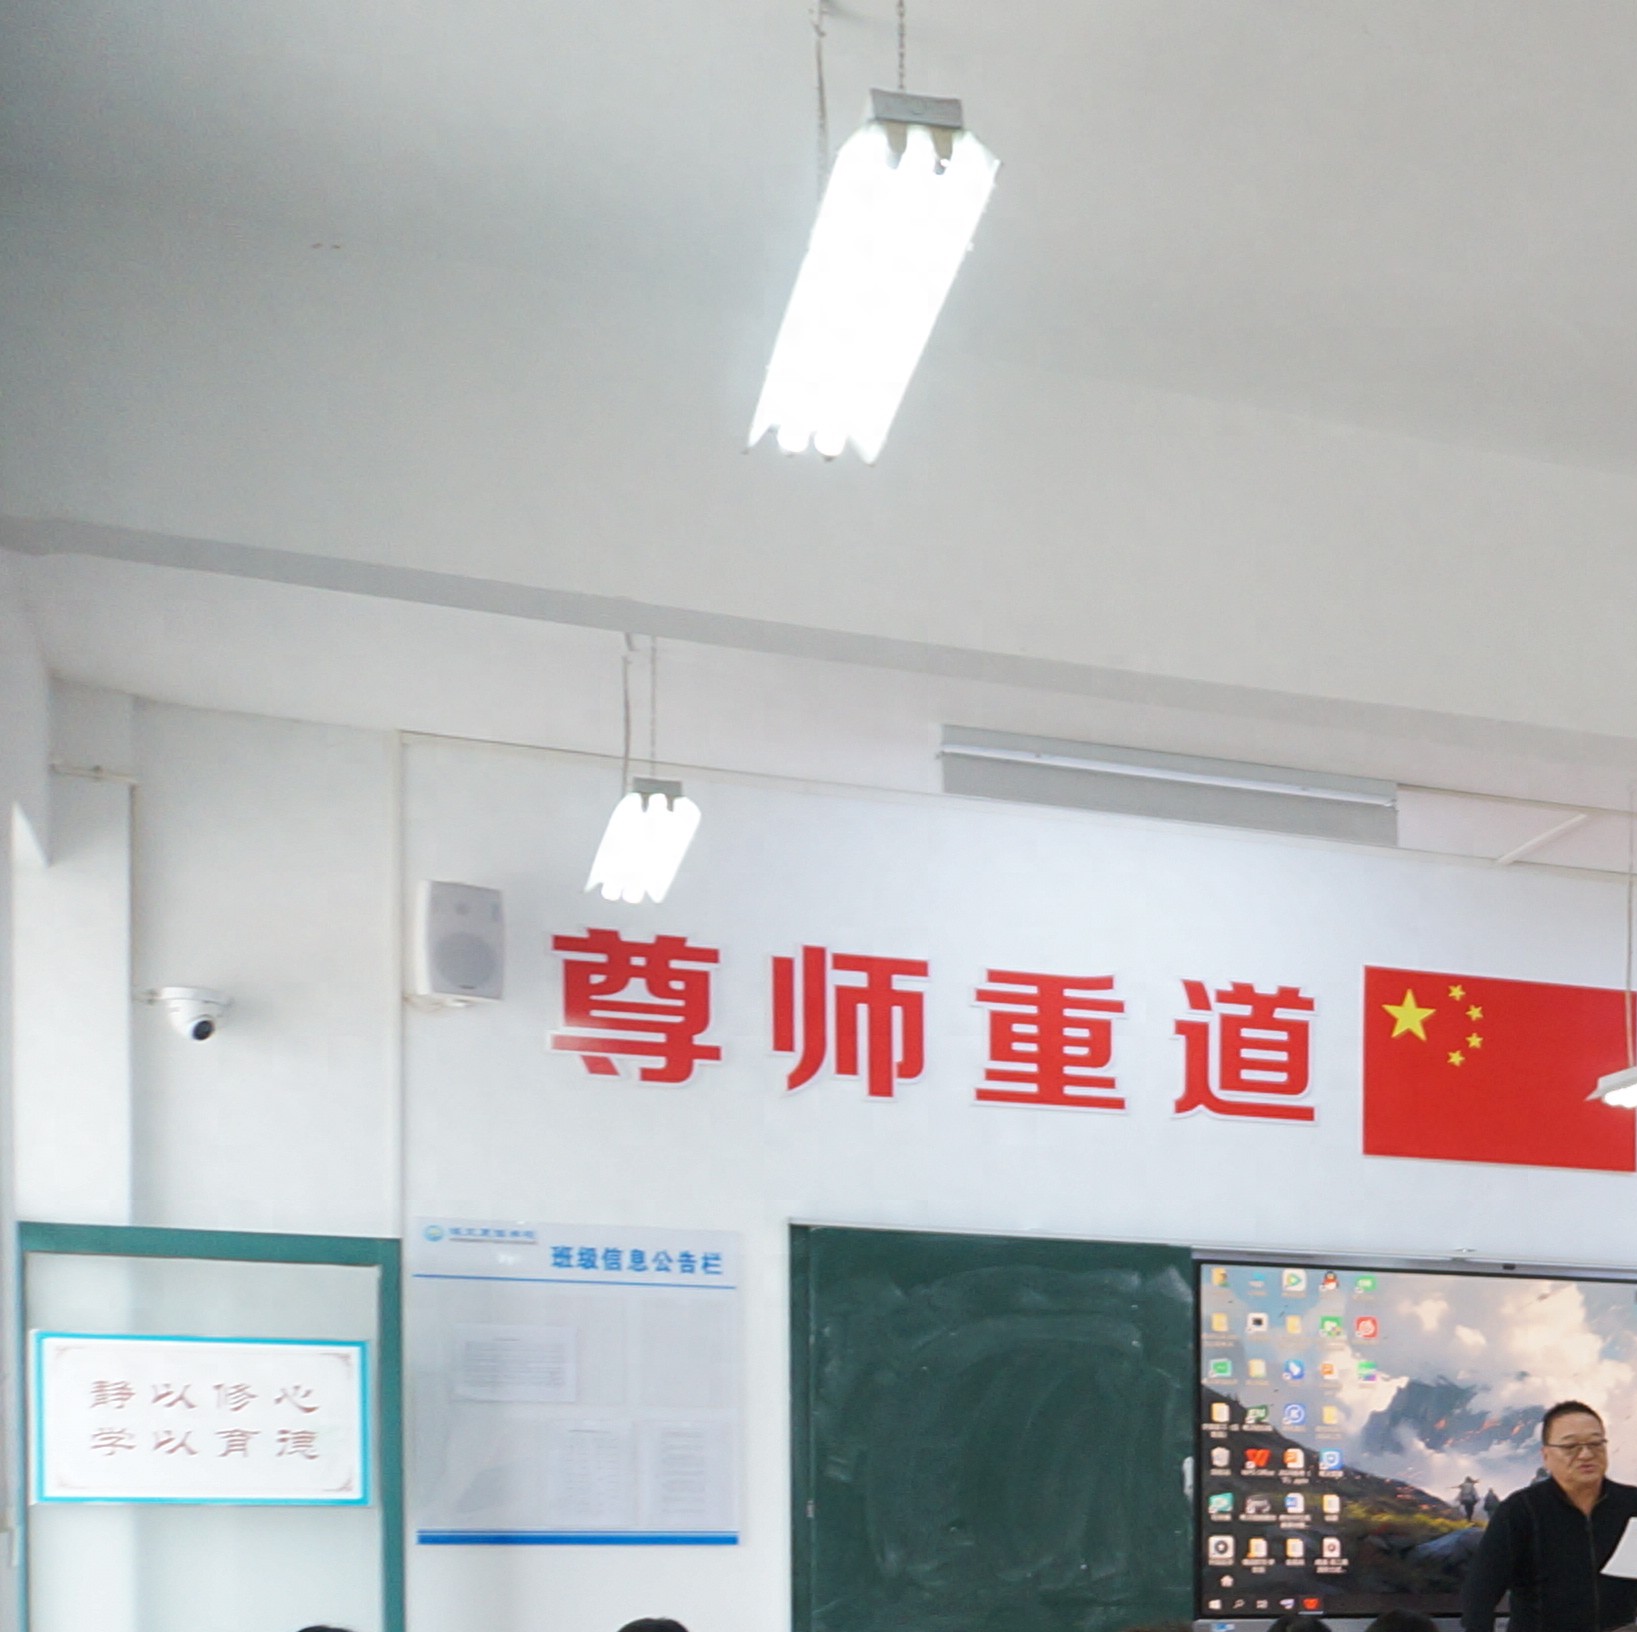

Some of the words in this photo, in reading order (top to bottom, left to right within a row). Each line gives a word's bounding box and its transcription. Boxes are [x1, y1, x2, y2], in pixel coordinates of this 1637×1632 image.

[549, 928, 1317, 1123] 尊师重道
[550, 1245, 723, 1276] 班级信息公告栏
[90, 1380, 319, 1413] 静以修心
[91, 1427, 319, 1460] 学以育德
